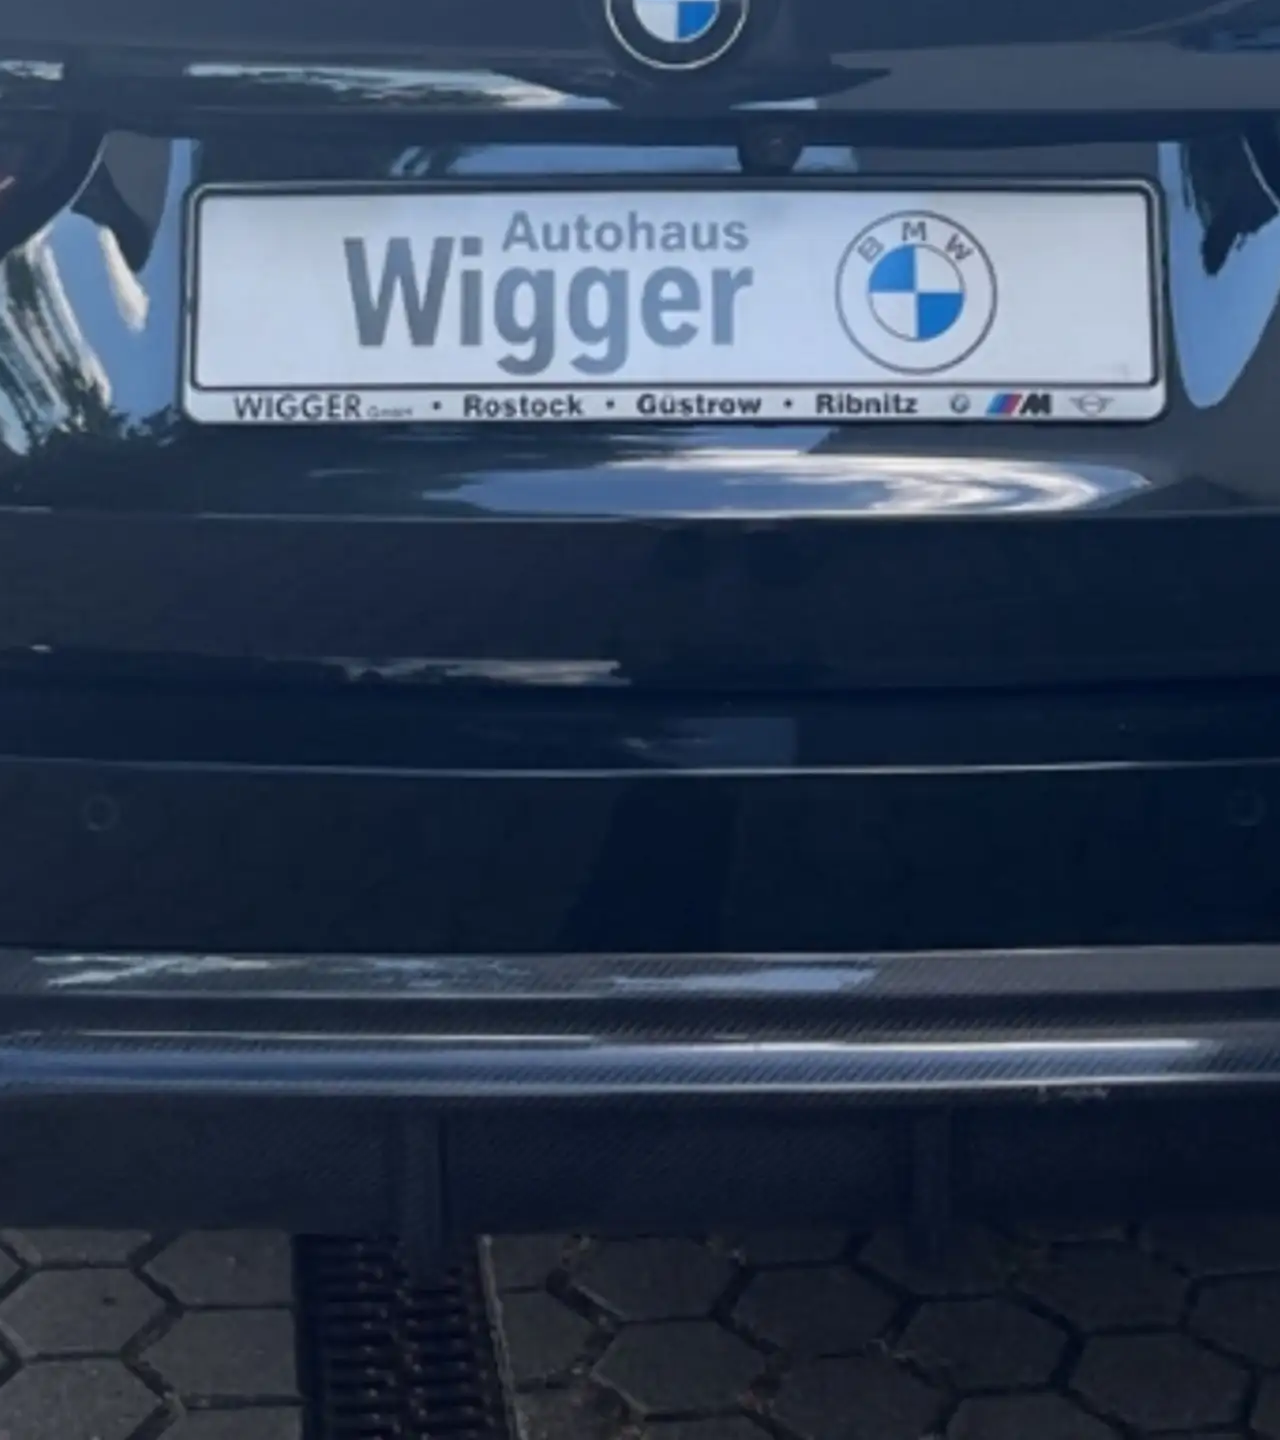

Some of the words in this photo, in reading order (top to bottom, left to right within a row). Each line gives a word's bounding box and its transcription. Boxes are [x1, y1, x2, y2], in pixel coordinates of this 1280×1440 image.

[502, 212, 749, 252] Autohaus
[857, 221, 973, 263] BMW
[343, 236, 754, 376] Wigger
[233, 393, 361, 419] WIGGER
[463, 394, 582, 417] Rostock
[636, 393, 762, 416] Güstrow
[816, 393, 918, 415] Ribnitz
